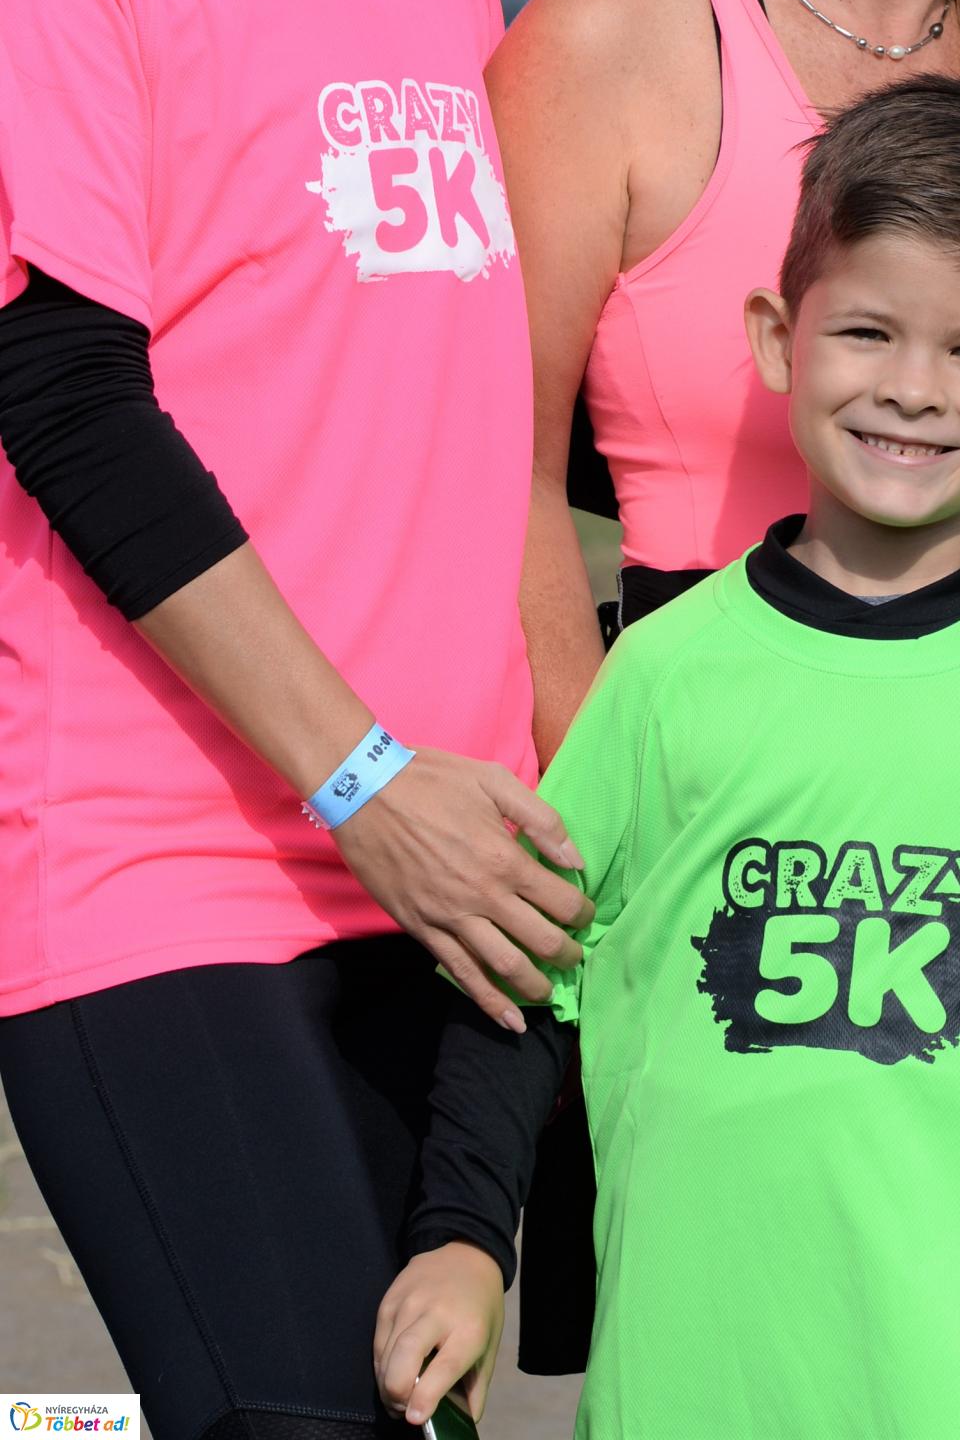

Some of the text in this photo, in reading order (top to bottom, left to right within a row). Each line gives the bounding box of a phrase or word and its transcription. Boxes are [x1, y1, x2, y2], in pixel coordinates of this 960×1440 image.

[318, 78, 486, 154] CRAZY
[367, 146, 491, 254] 5K
[336, 776, 354, 795] 5K
[754, 914, 951, 1034] 5K
